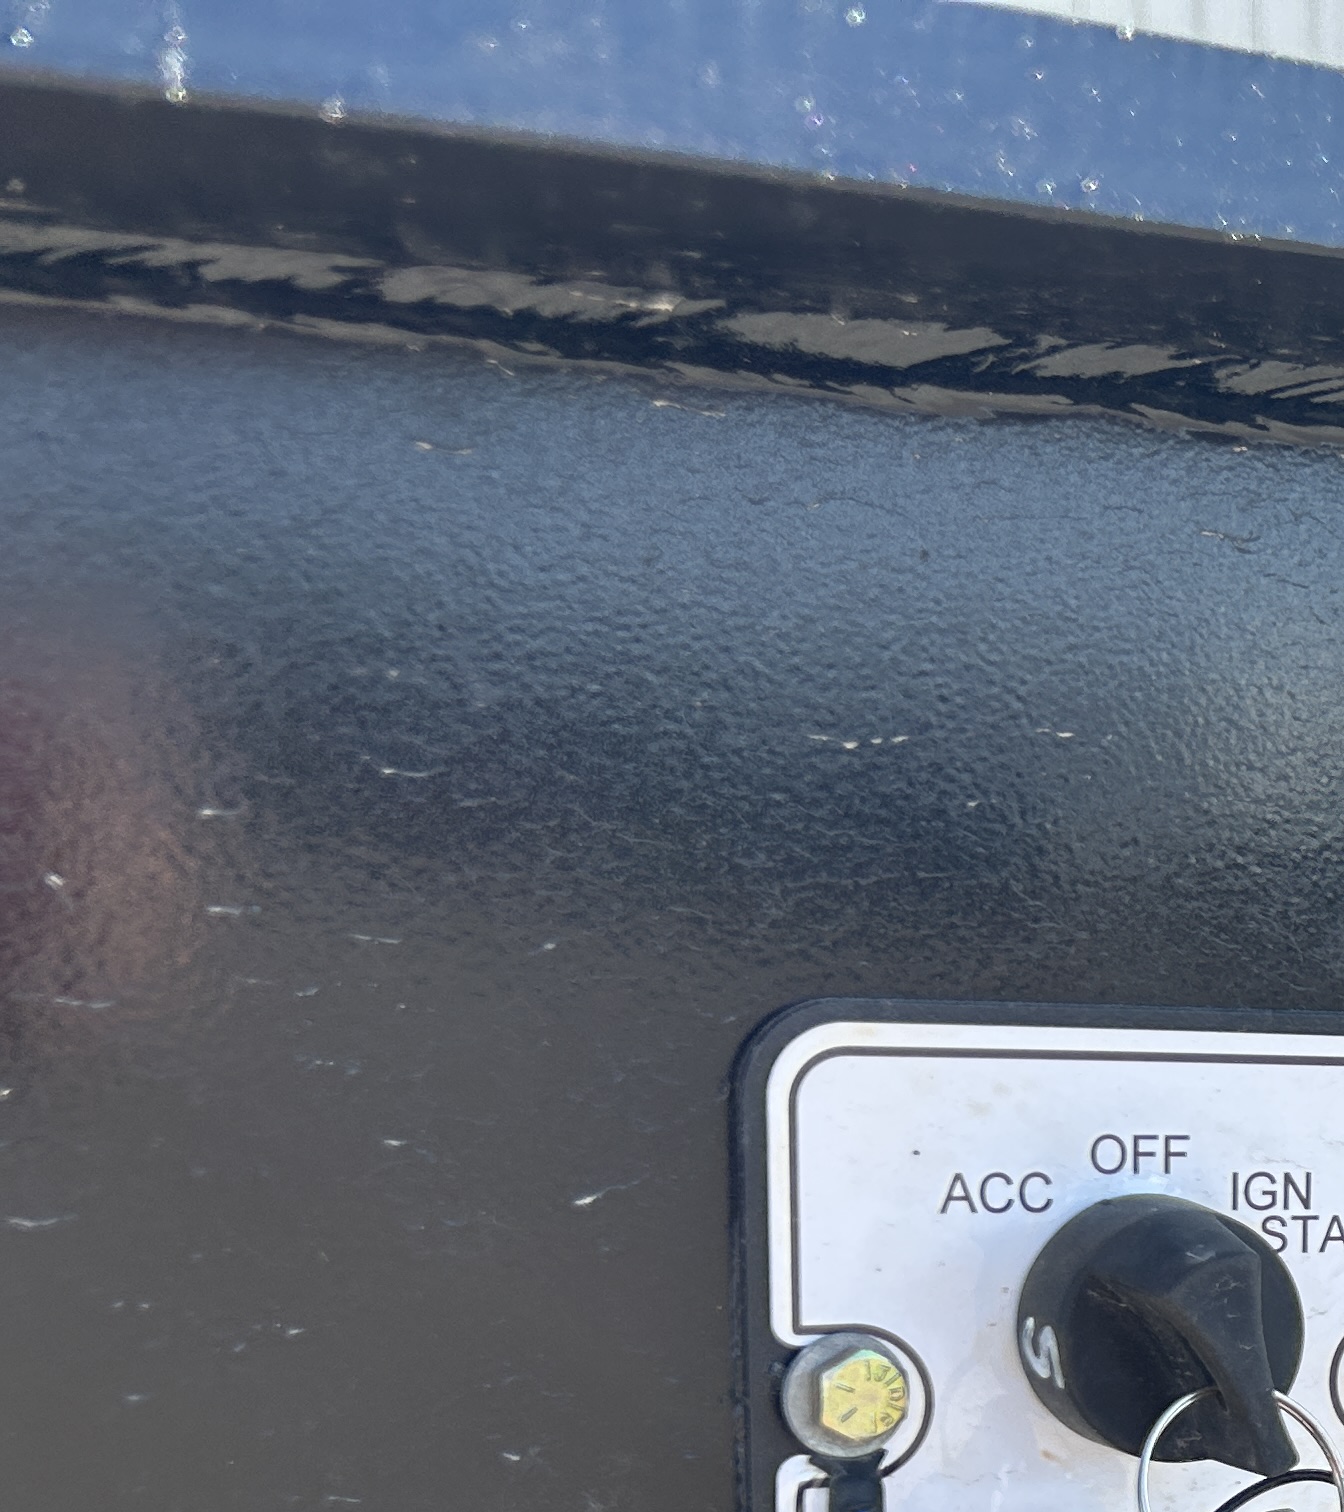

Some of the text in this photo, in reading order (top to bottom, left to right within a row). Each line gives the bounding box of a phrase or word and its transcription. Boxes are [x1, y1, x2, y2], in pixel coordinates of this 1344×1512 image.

[1089, 1133, 1191, 1176] OFF
[940, 1172, 1054, 1215] ACC
[1232, 1171, 1312, 1211] IGN
